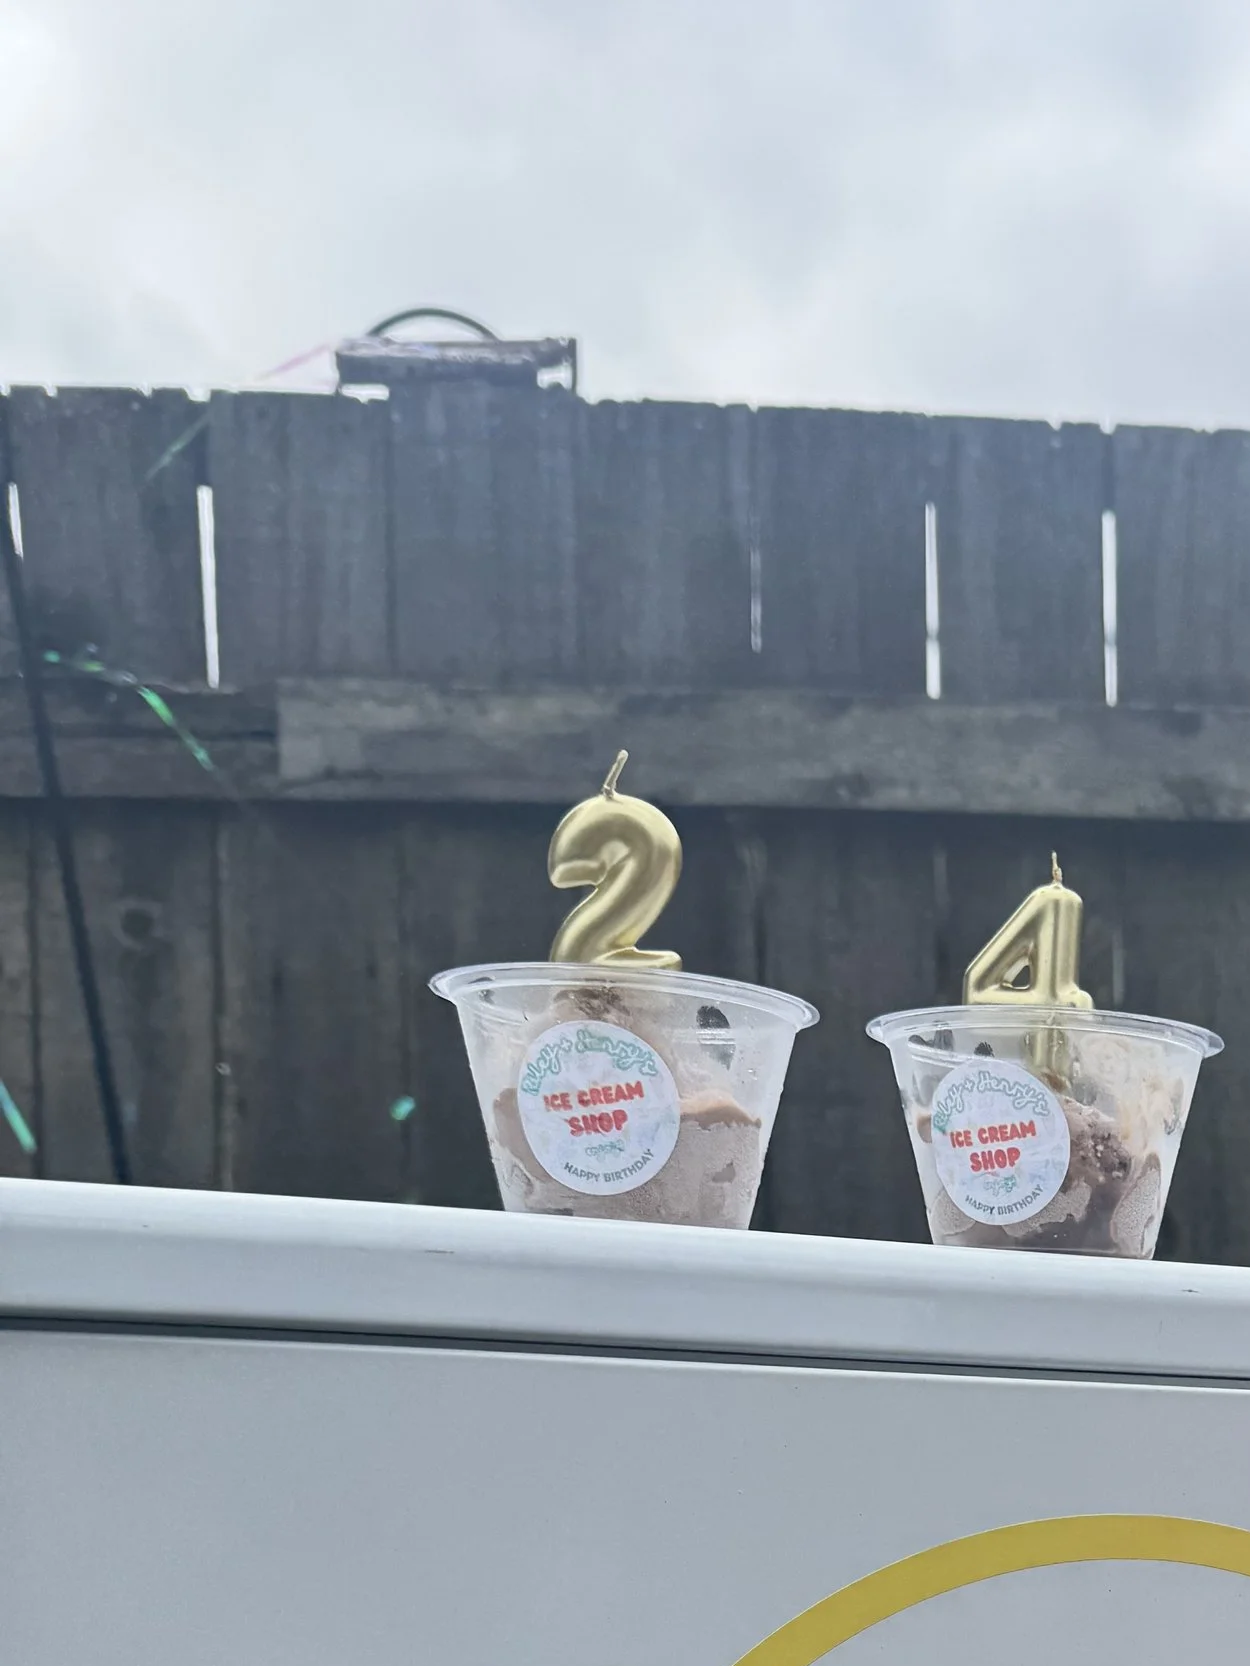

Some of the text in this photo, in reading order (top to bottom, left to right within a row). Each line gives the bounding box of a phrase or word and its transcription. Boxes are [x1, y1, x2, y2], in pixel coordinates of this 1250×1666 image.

[547, 792, 683, 970] 2
[963, 883, 1095, 1015] 4
[543, 1080, 645, 1113] ICE CREAM
[977, 1070, 1050, 1117] Henry's
[568, 1109, 629, 1137] SHOP
[949, 1119, 1037, 1149] ICE CREAM
[564, 1161, 600, 1183] HAPPY
[603, 1148, 655, 1183] BIRTHDAY
[969, 1147, 1021, 1173] SHOP
[964, 1194, 995, 1215] HAPPY
[997, 1183, 1045, 1216] BIRTHDAY
